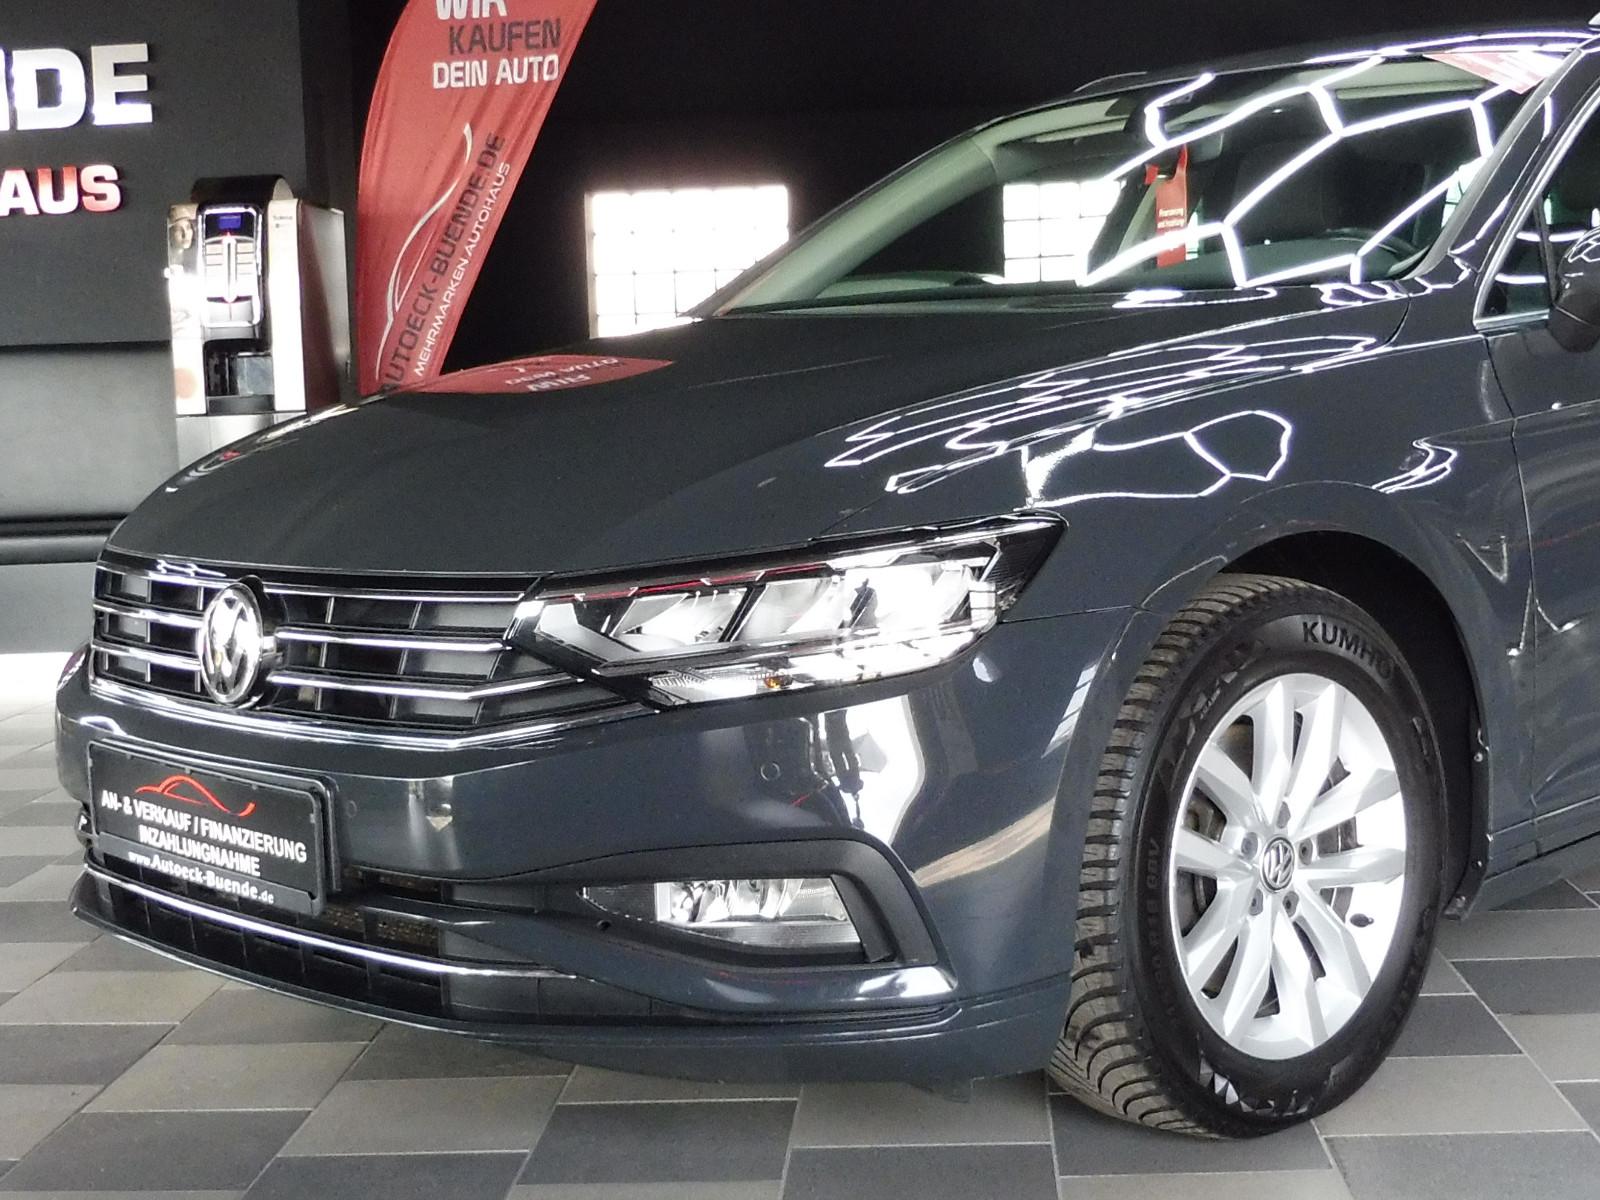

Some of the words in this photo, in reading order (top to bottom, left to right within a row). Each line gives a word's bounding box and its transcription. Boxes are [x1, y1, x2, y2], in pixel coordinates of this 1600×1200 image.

[449, 18, 560, 55] KAUFEN
[0, 43, 153, 131] DE
[433, 60, 487, 89] DEIN
[495, 54, 560, 85] AUTO
[414, 256, 470, 377] MEHRMARKEN
[466, 161, 511, 257] AUTOHAUS
[1302, 621, 1394, 680] KUMHO
[133, 799, 192, 831] VERKAUF
[200, 817, 308, 863] FINANZIERUNG
[138, 825, 262, 877] INZAHLUNGNAHME
[128, 851, 274, 904] www.Autoeck-Buende.de
